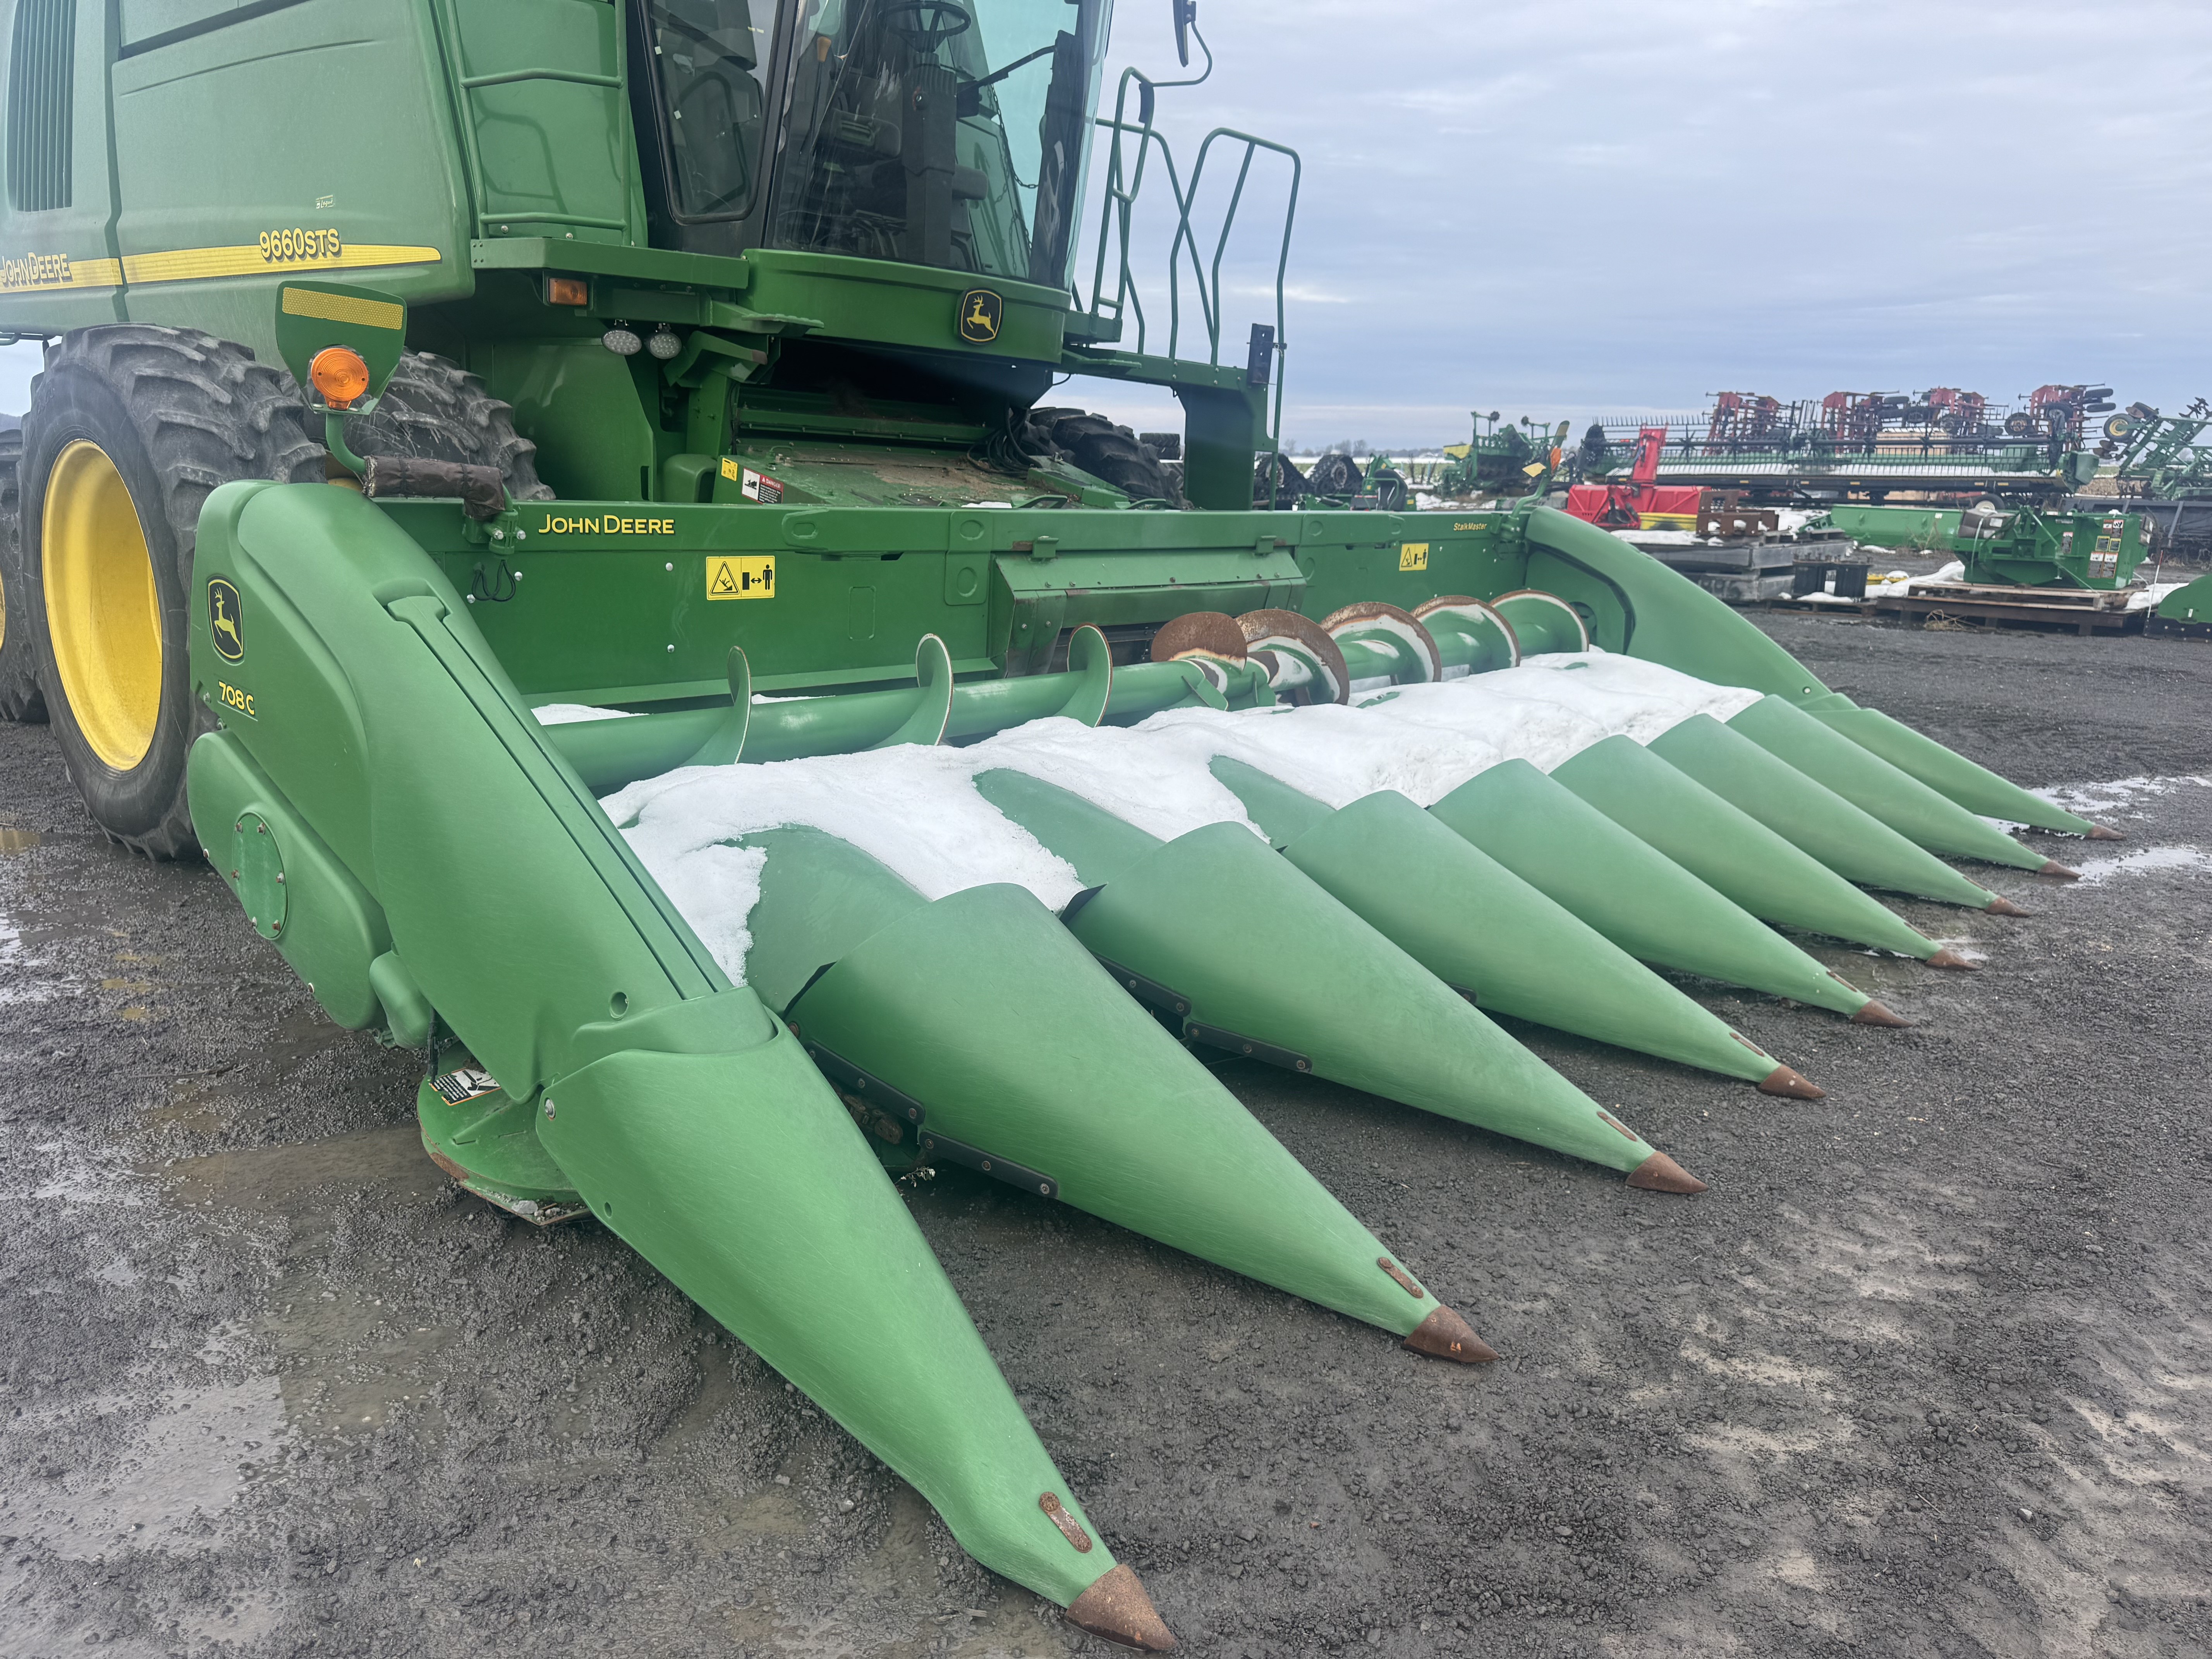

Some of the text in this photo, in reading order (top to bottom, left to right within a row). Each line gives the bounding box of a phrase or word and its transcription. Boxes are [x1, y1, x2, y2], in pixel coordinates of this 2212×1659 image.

[259, 228, 340, 260] 9660STS
[0, 252, 71, 284] JOHN DEERE
[766, 478, 781, 489] DANGER
[538, 514, 675, 534] JOHN DEERE
[1453, 522, 1487, 531] StalkMaster
